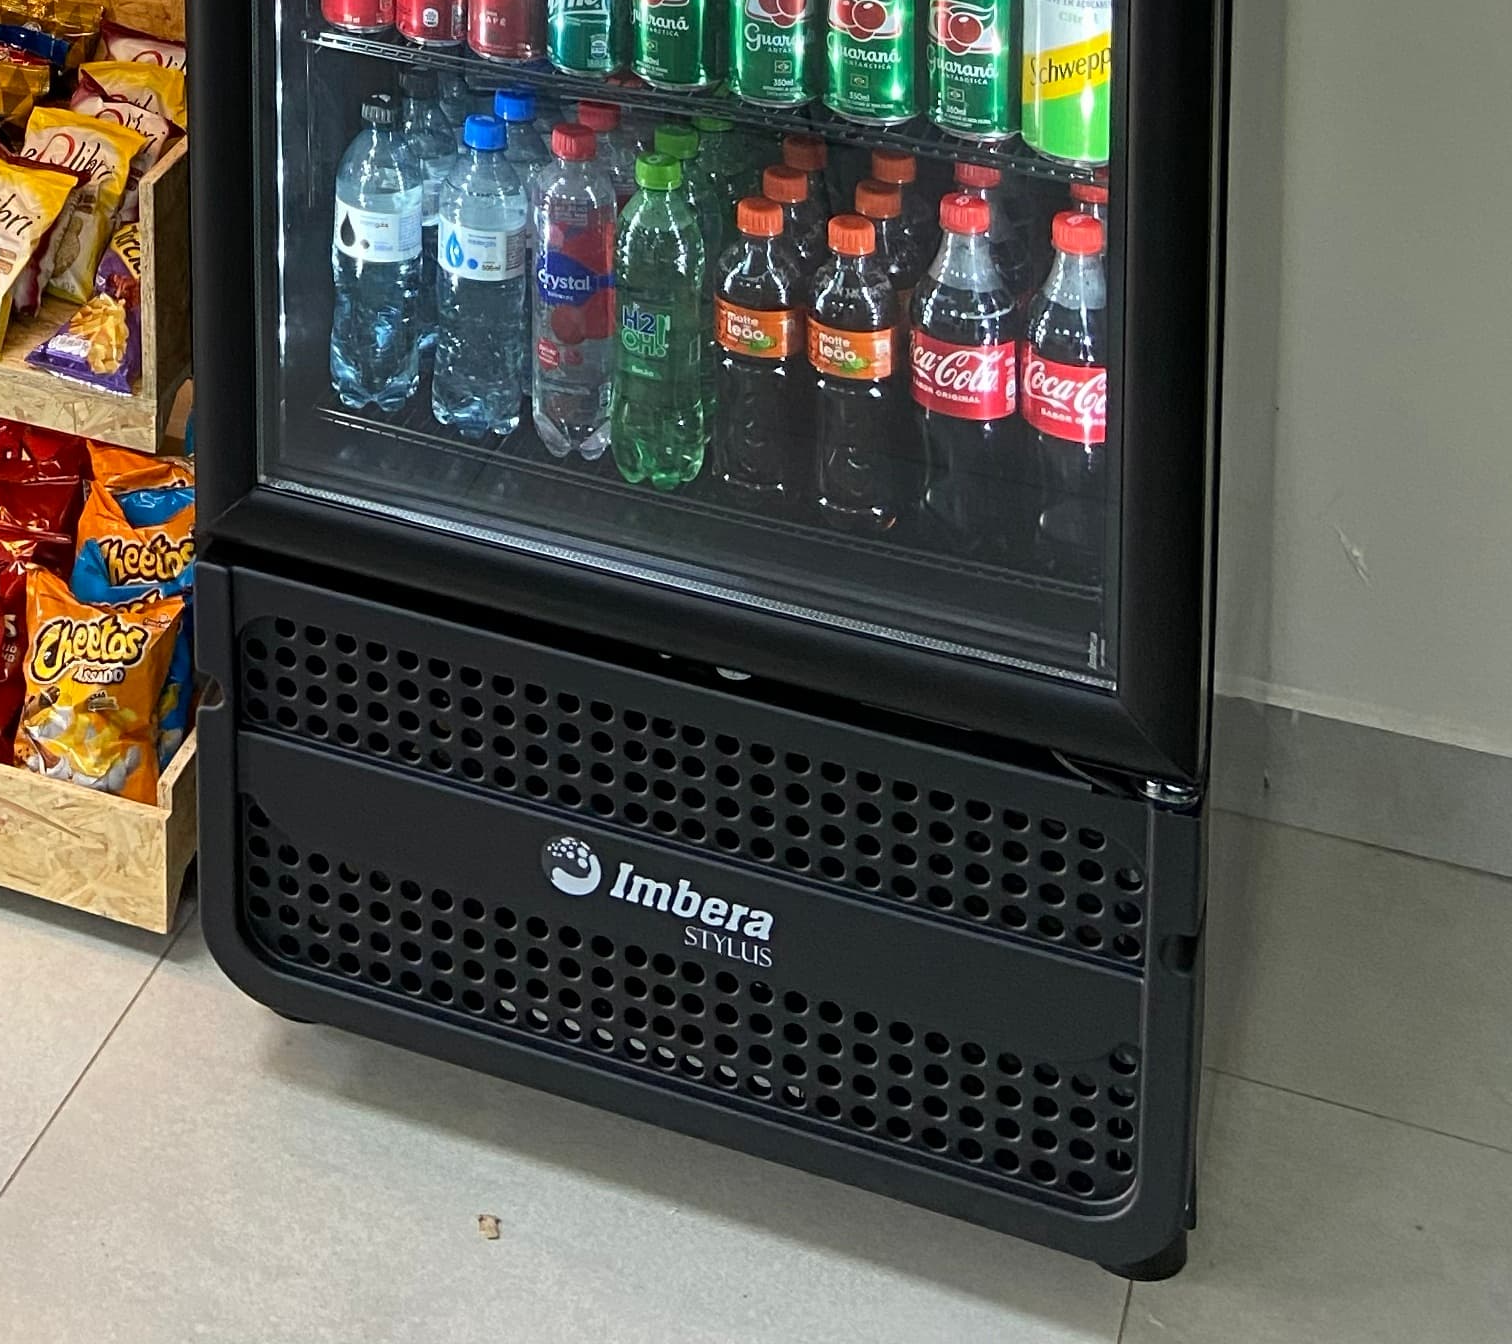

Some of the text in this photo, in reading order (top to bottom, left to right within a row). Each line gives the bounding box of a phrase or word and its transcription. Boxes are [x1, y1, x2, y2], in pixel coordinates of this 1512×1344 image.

[1029, 46, 1112, 86] Schwepp
[727, 311, 759, 326] matte
[819, 332, 851, 347] matte
[31, 614, 147, 683] Cheetos
[73, 666, 126, 684] ASSADO
[609, 861, 775, 941] Imbera
[684, 925, 774, 968] STYLUS
